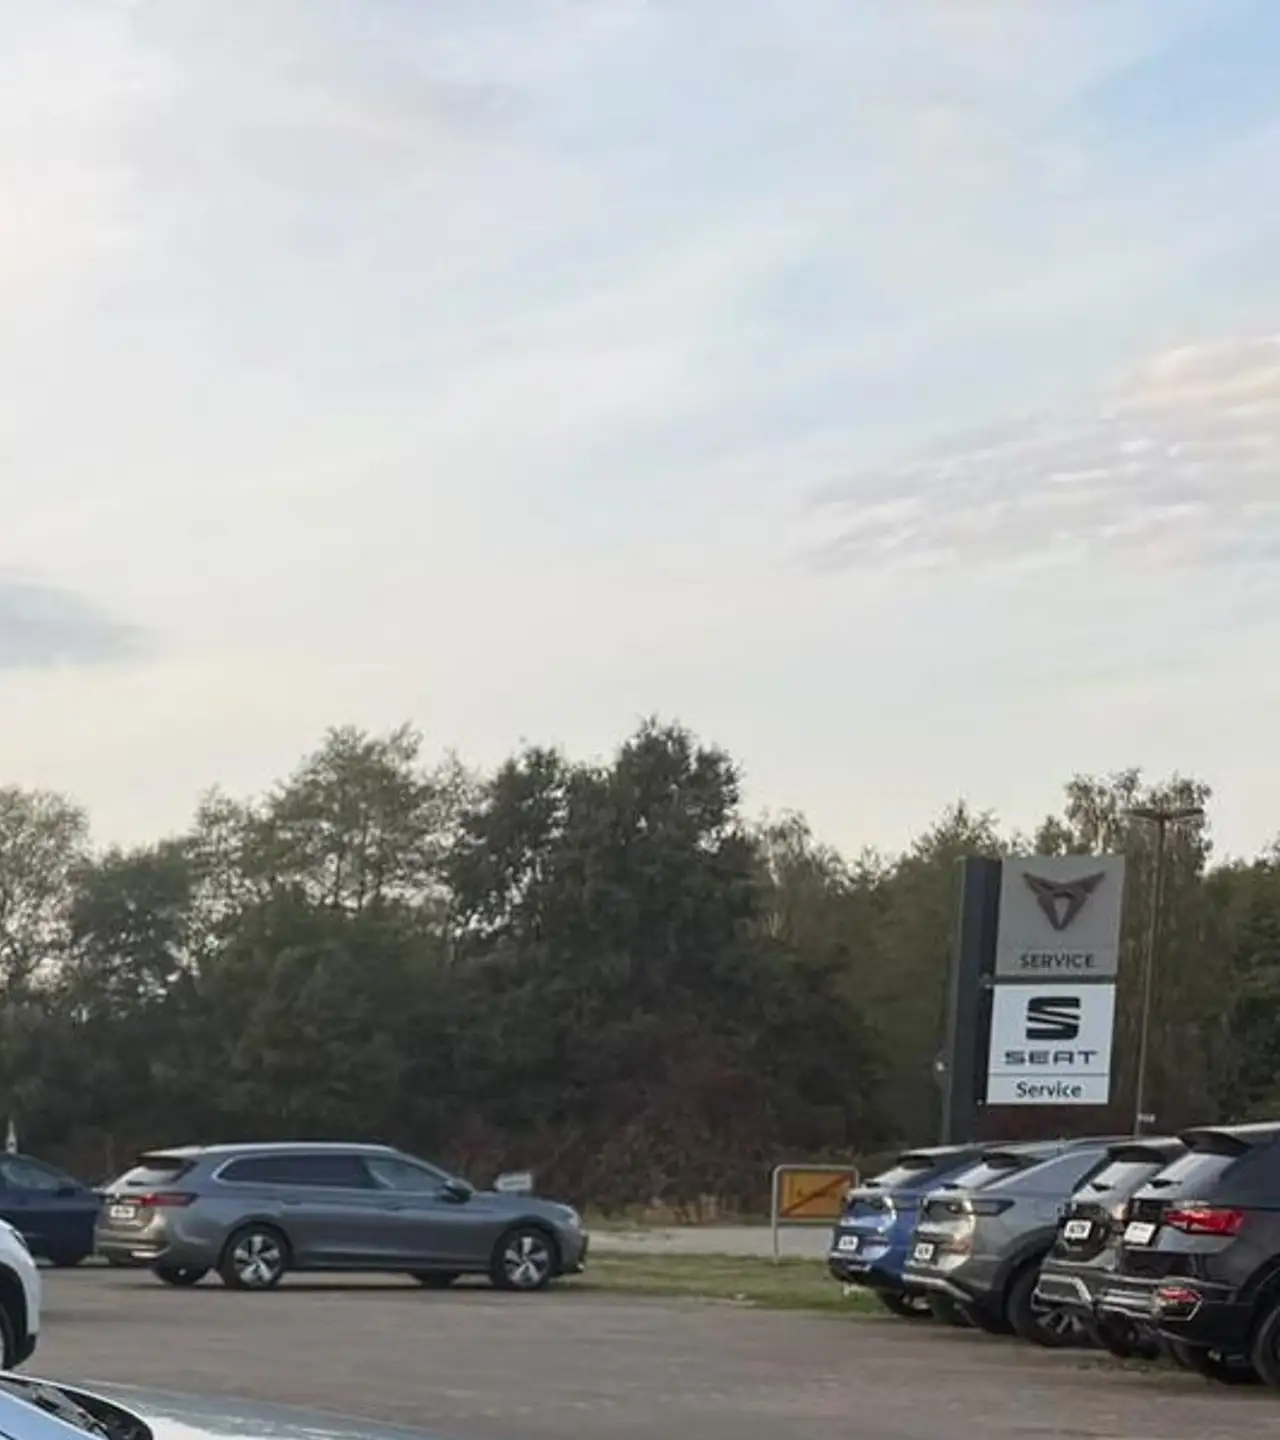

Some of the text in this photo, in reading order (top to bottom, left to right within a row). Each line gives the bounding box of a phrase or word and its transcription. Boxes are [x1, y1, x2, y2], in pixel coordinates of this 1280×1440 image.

[1020, 953, 1096, 968] SERVICE
[1004, 1051, 1097, 1065] SEAT
[1016, 1081, 1082, 1097] Service
